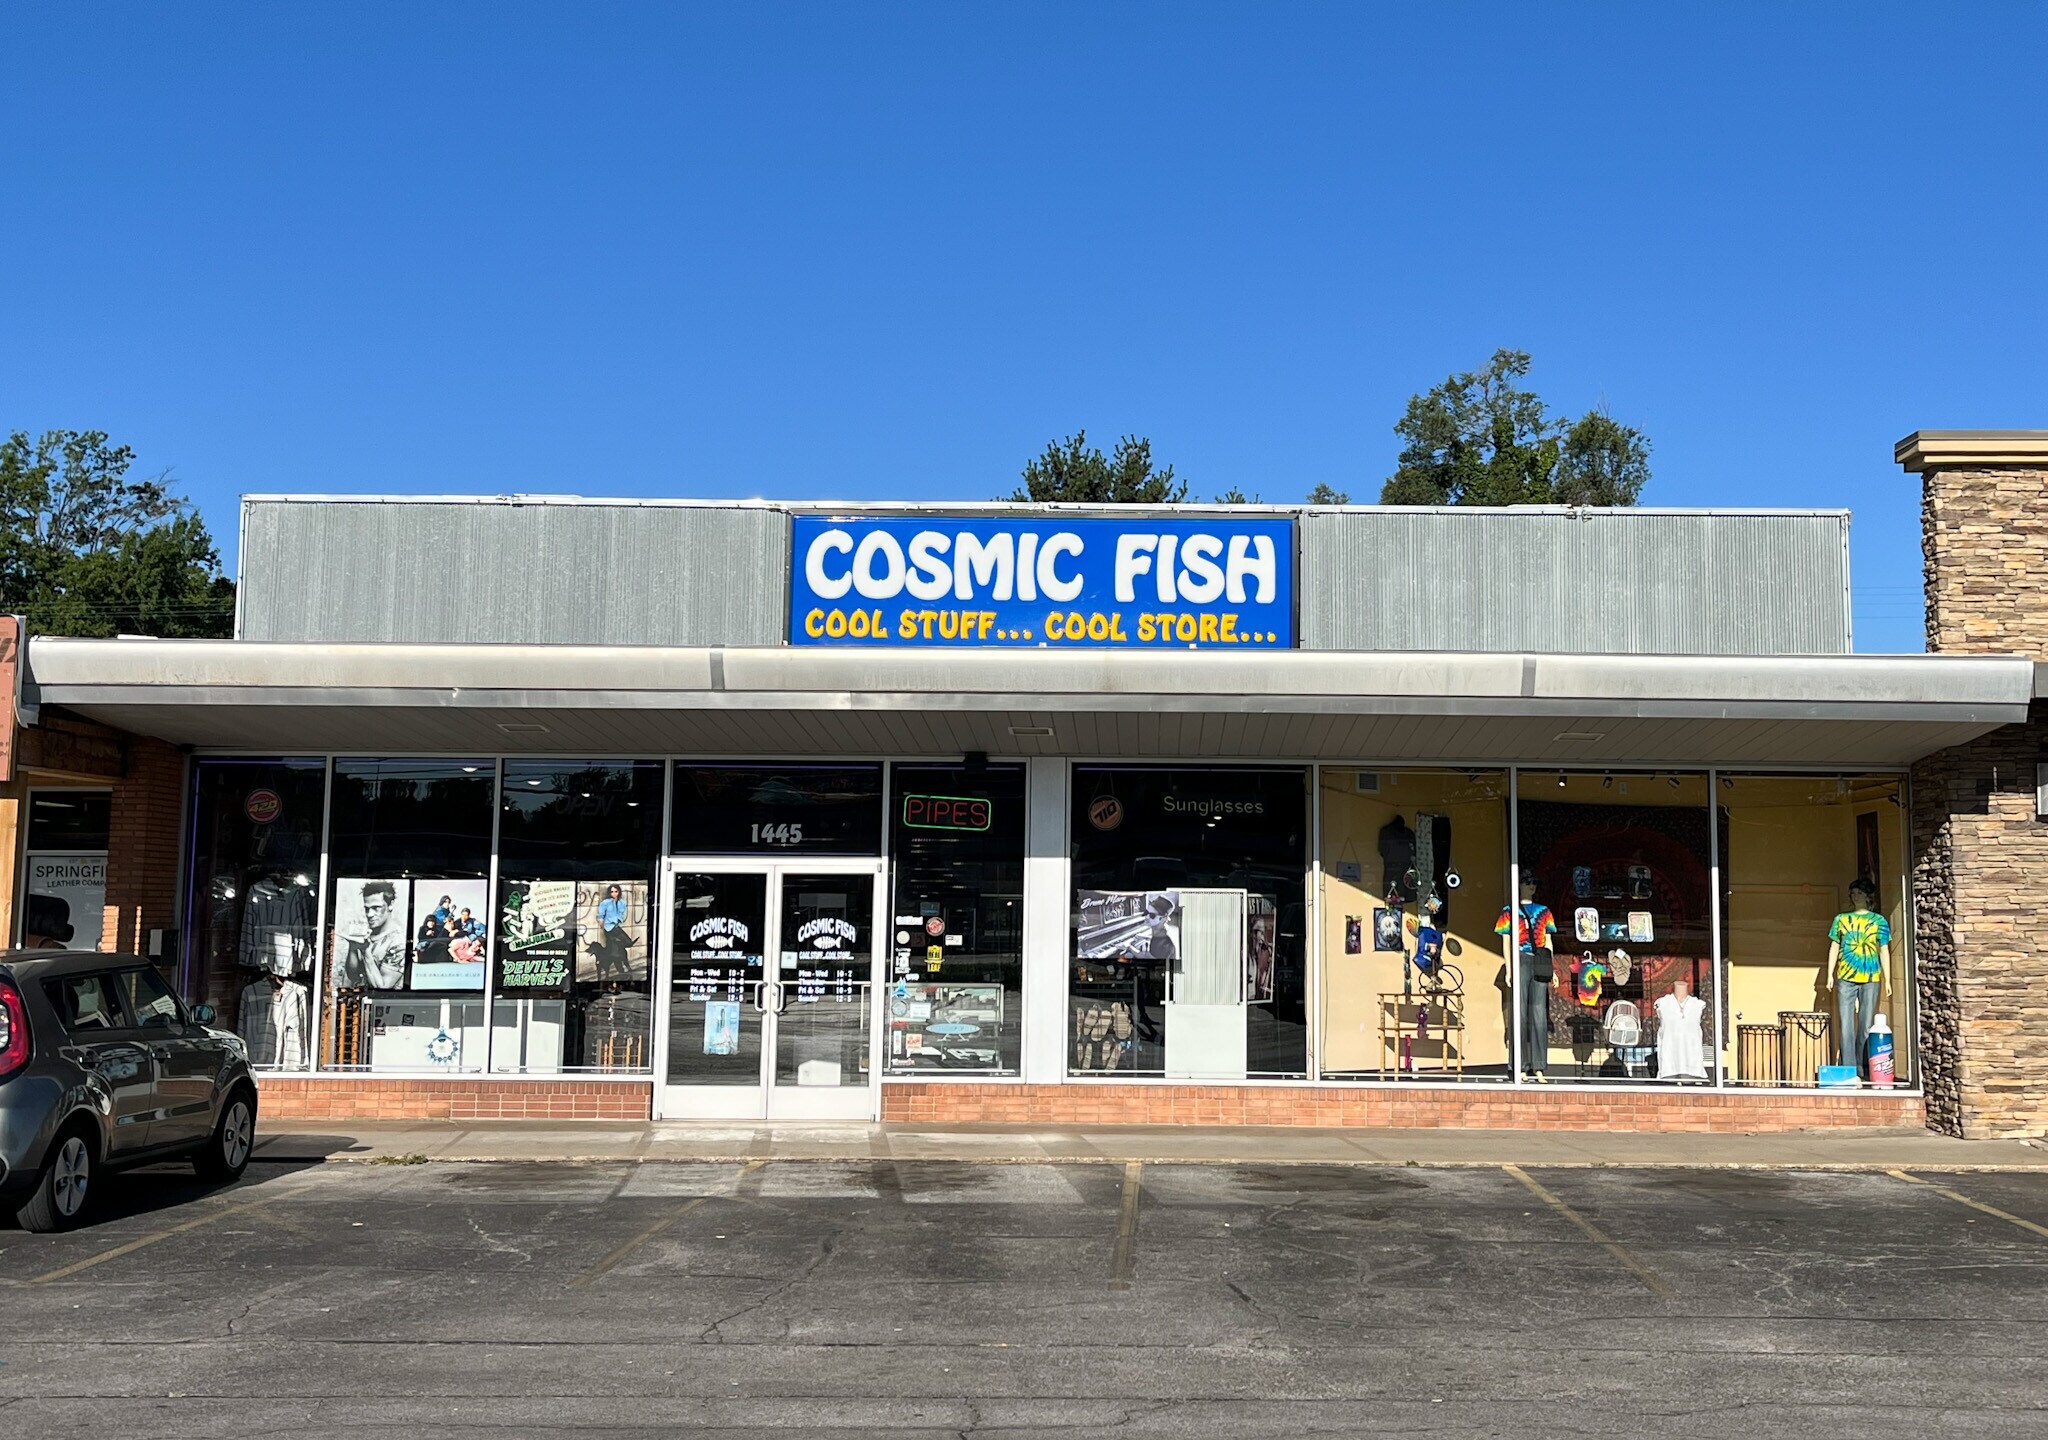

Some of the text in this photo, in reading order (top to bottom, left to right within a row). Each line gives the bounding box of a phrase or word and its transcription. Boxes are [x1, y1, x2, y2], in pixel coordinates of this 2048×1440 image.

[805, 529, 1276, 604] COSMIC FISH
[805, 609, 1277, 643] COOL STUFF... COOL STORE...
[908, 800, 986, 826] PIPES
[1164, 796, 1264, 816] Sunglasses
[751, 823, 802, 843] 1445
[36, 865, 104, 878] SPRINGFI
[47, 880, 81, 888] LEATHER
[690, 917, 748, 942] COSMIC FISH
[798, 917, 856, 943] COSMIC FISH
[515, 932, 556, 949] MARIJUANA
[503, 958, 564, 975] DEVIL'S
[503, 972, 567, 986] HARVEST
